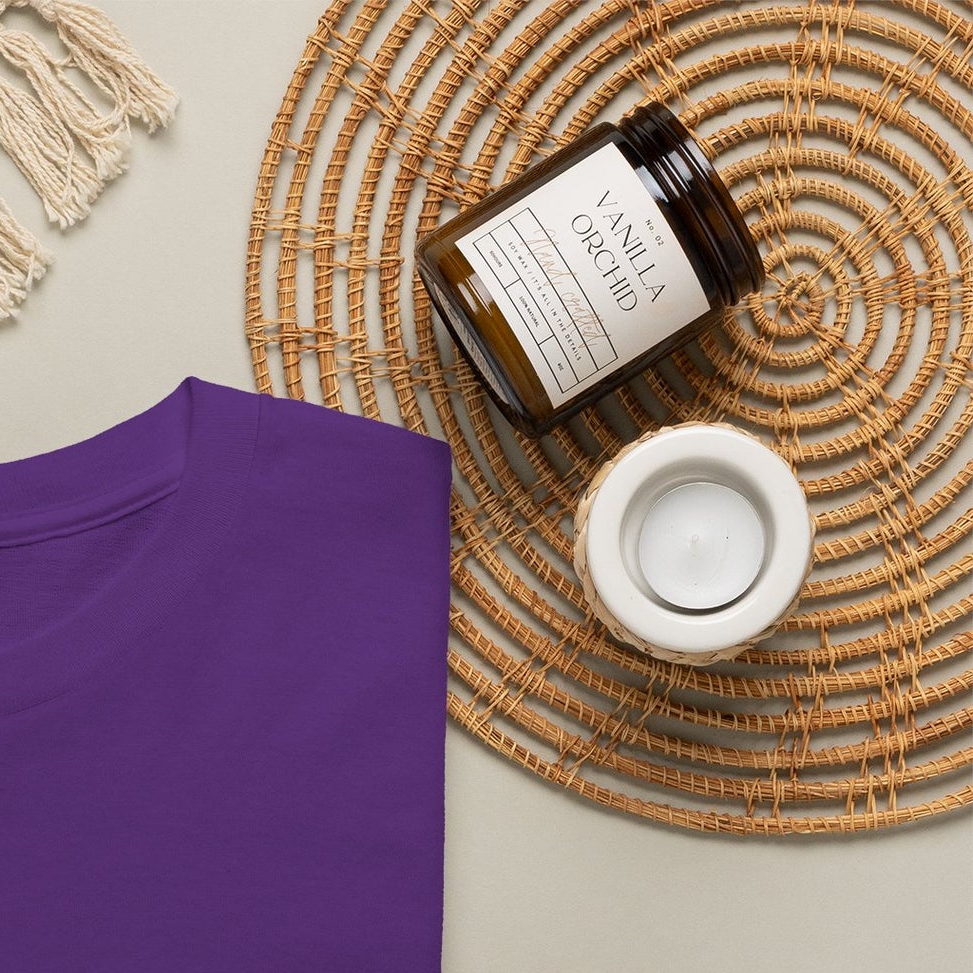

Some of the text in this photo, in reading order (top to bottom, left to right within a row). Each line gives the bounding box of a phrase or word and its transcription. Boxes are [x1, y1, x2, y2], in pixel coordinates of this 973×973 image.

[571, 214, 638, 311] ORCHID
[597, 190, 666, 302] VANILLA
[645, 219, 664, 246] No. 02
[508, 241, 518, 254] SOY
[518, 255, 528, 269] WAX
[542, 293, 551, 306] ALL
[550, 308, 557, 317] IN
[556, 318, 566, 332] THE
[565, 334, 582, 361] DETAILS
[527, 307, 540, 328] NATURAL
